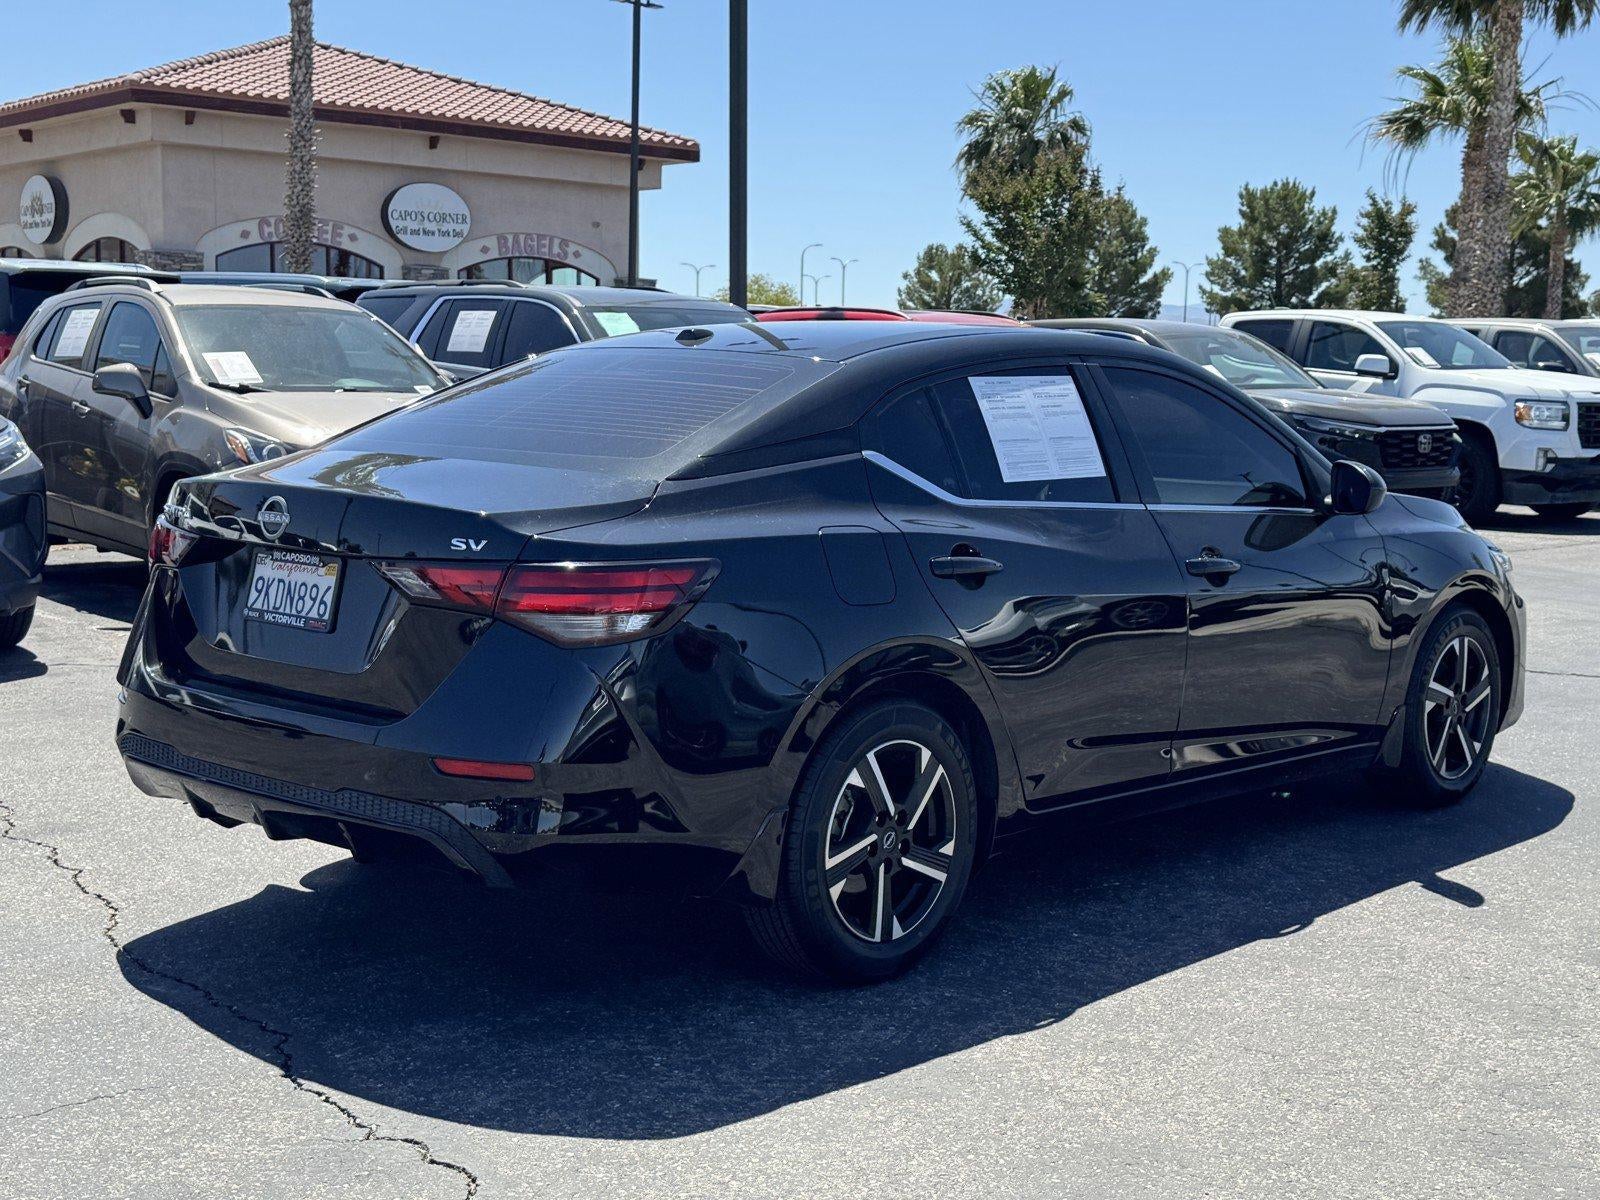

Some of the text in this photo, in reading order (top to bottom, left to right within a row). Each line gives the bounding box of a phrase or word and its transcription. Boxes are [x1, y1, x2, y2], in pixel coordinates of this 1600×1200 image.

[391, 208, 468, 225] CAPO'S CORNER
[258, 217, 344, 246] COEE
[395, 225, 408, 236] Grill
[410, 227, 420, 236] and
[421, 227, 436, 237] New
[437, 228, 451, 237] York
[497, 233, 569, 260] BAGELS
[450, 537, 488, 551] SV
[281, 551, 311, 564] CAPOSIO
[250, 576, 332, 619] 9KDN896
[264, 612, 306, 627] VICTORVILLE
